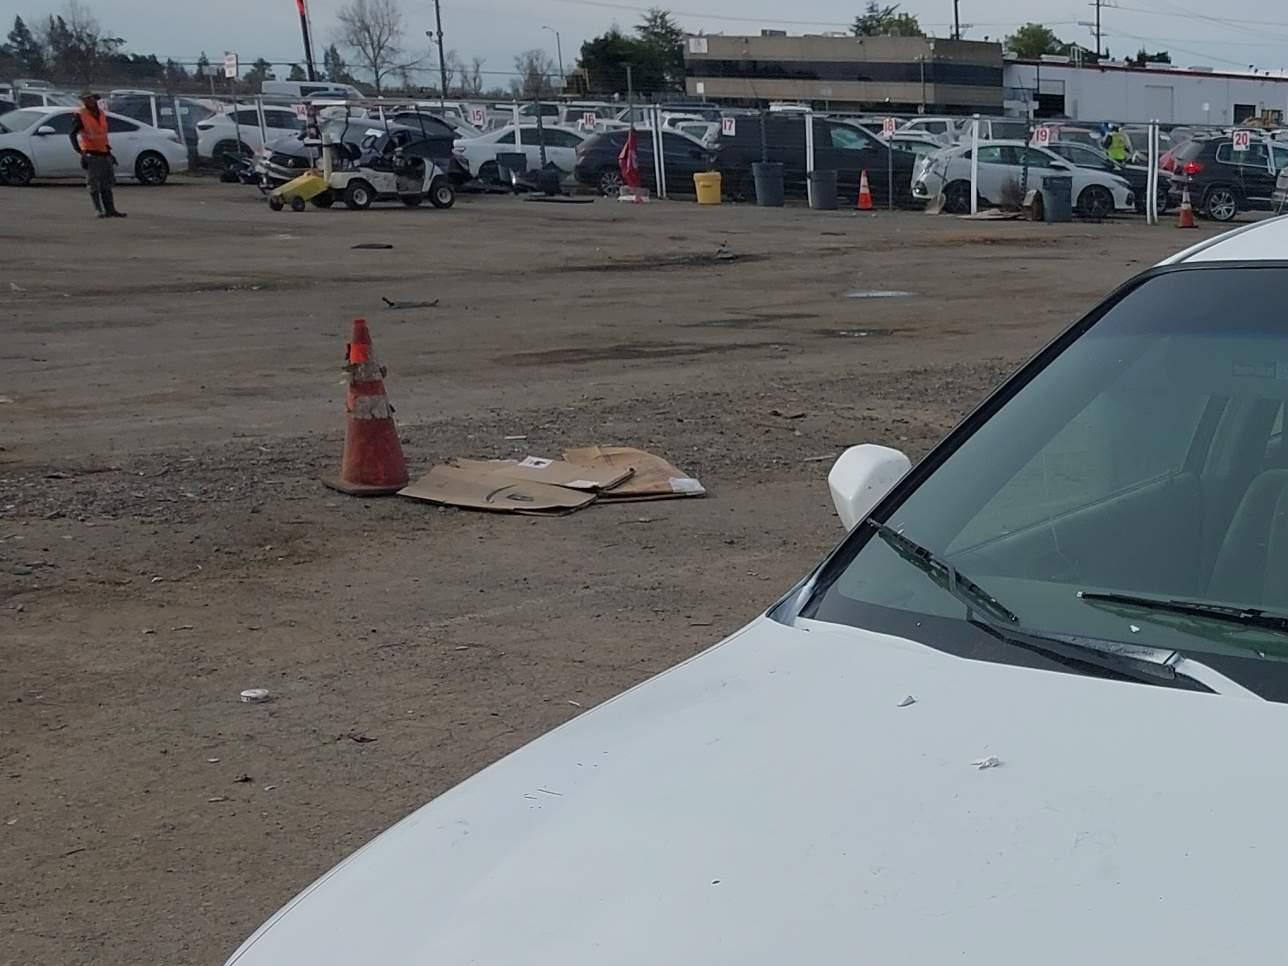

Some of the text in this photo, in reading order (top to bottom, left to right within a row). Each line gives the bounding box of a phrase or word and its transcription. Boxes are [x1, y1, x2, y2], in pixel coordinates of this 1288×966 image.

[472, 110, 482, 121] 15
[584, 114, 595, 125] 16
[723, 119, 733, 130] 17
[884, 119, 894, 131] 18
[1036, 130, 1048, 142] 19
[1235, 133, 1248, 146] 20
